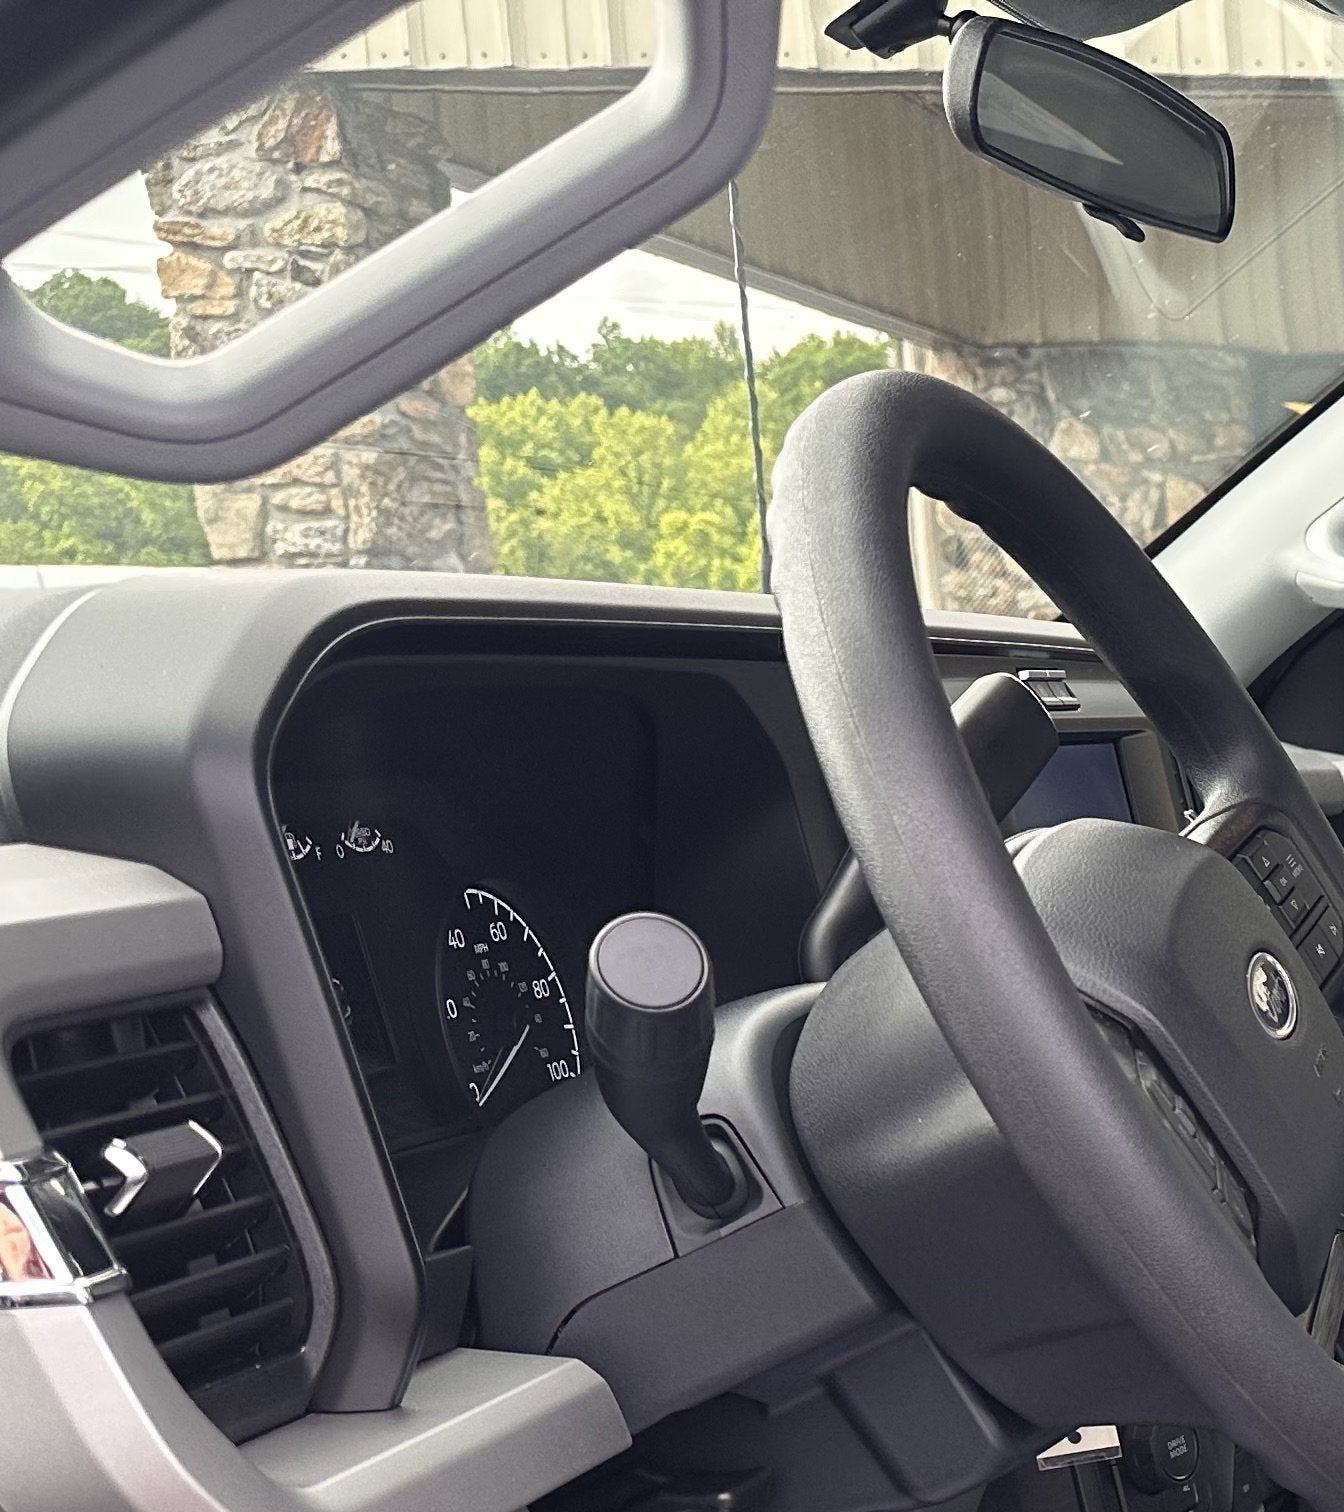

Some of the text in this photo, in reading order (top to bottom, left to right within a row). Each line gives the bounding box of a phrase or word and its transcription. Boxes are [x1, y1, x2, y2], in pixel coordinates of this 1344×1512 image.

[448, 928, 466, 949] 40
[489, 921, 508, 942] 60
[532, 979, 550, 999] 80
[547, 1059, 570, 1081] 100
[1168, 1435, 1186, 1450] DRIVE
[1170, 1445, 1187, 1458] MODE
